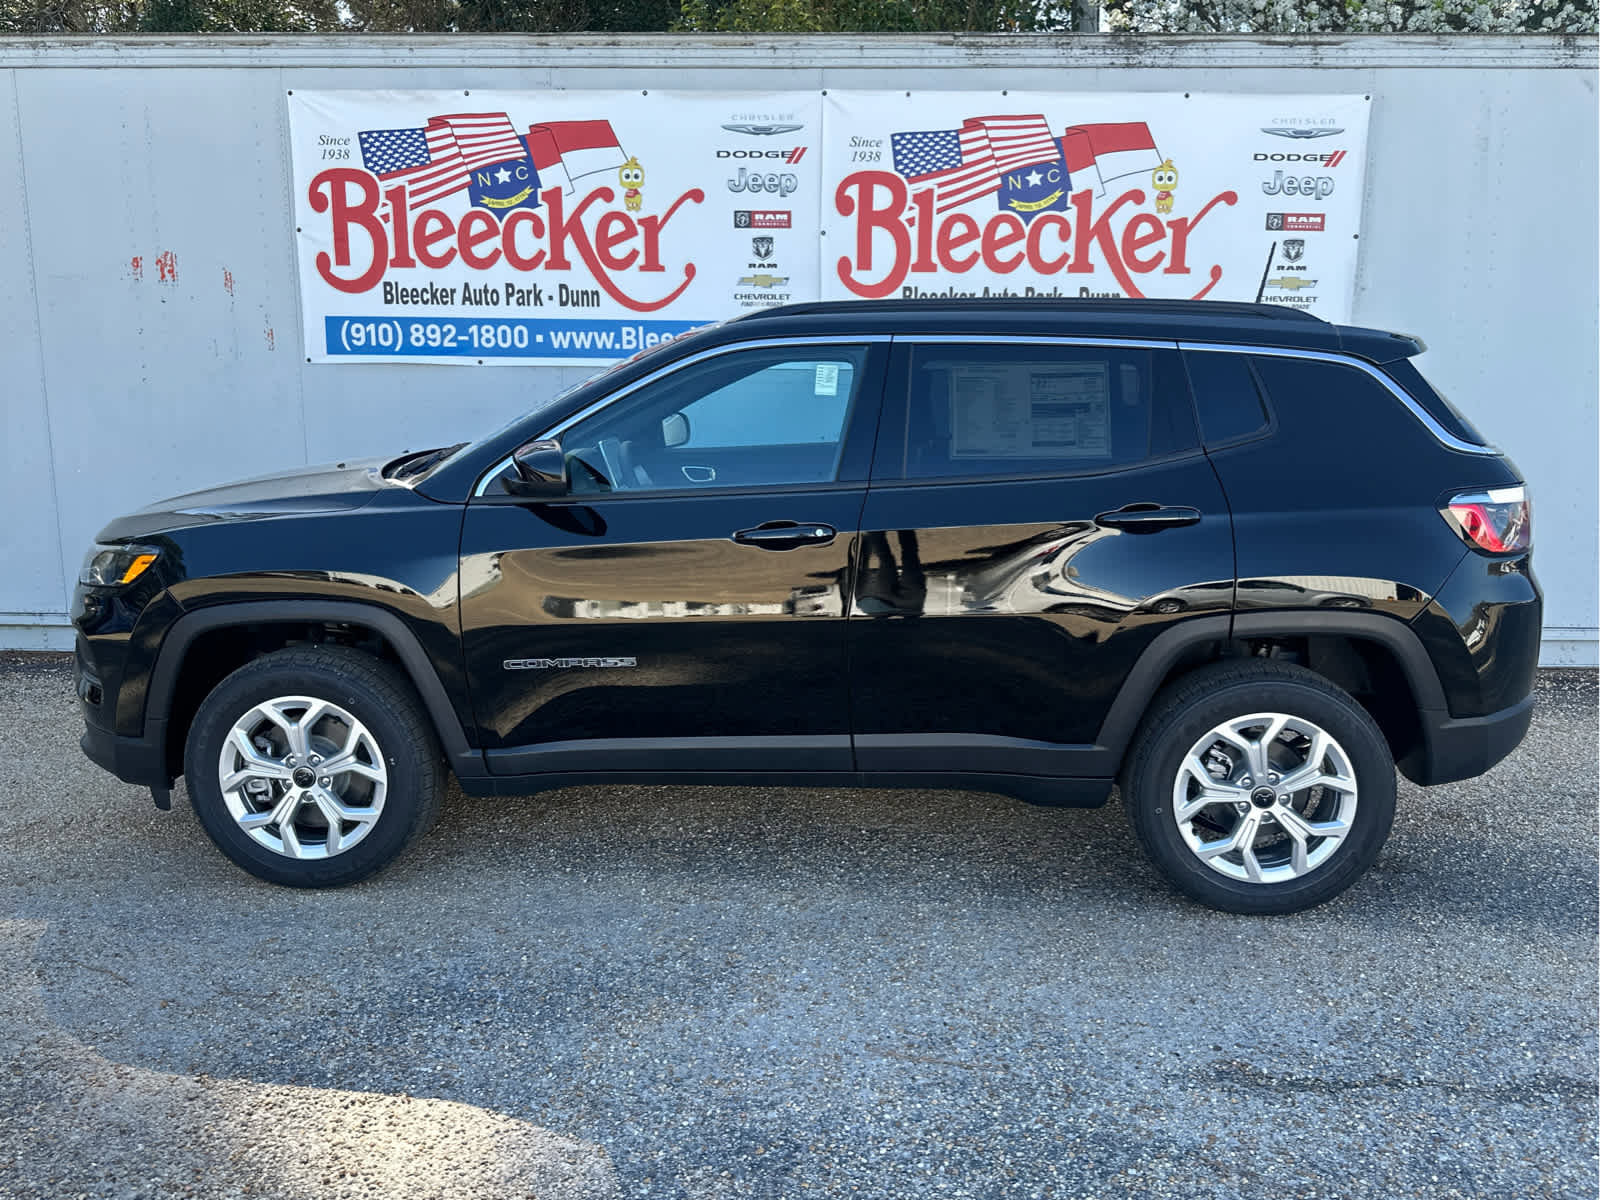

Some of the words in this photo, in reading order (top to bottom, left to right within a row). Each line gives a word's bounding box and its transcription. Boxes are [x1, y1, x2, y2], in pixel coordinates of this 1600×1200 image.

[318, 134, 351, 146] Since
[849, 136, 883, 148] Since
[320, 149, 351, 160] 1938
[716, 150, 793, 159] DODGE
[851, 151, 882, 162] 1938
[1253, 153, 1333, 162] DODGE
[477, 172, 492, 187] N
[515, 165, 529, 180] C
[727, 168, 798, 197] Jeep
[1008, 174, 1022, 190] N
[1047, 168, 1061, 183] C
[1262, 170, 1335, 200] Jeep
[308, 167, 705, 312] Bleecker
[835, 170, 1238, 299] Bleecker
[383, 281, 456, 304] Bleecker
[461, 283, 501, 306] Auto
[505, 283, 544, 306] Park
[558, 284, 601, 307] Dunn
[341, 320, 403, 351] (910)
[409, 323, 529, 348] 892-1800
[503, 657, 637, 670] COMPASS
